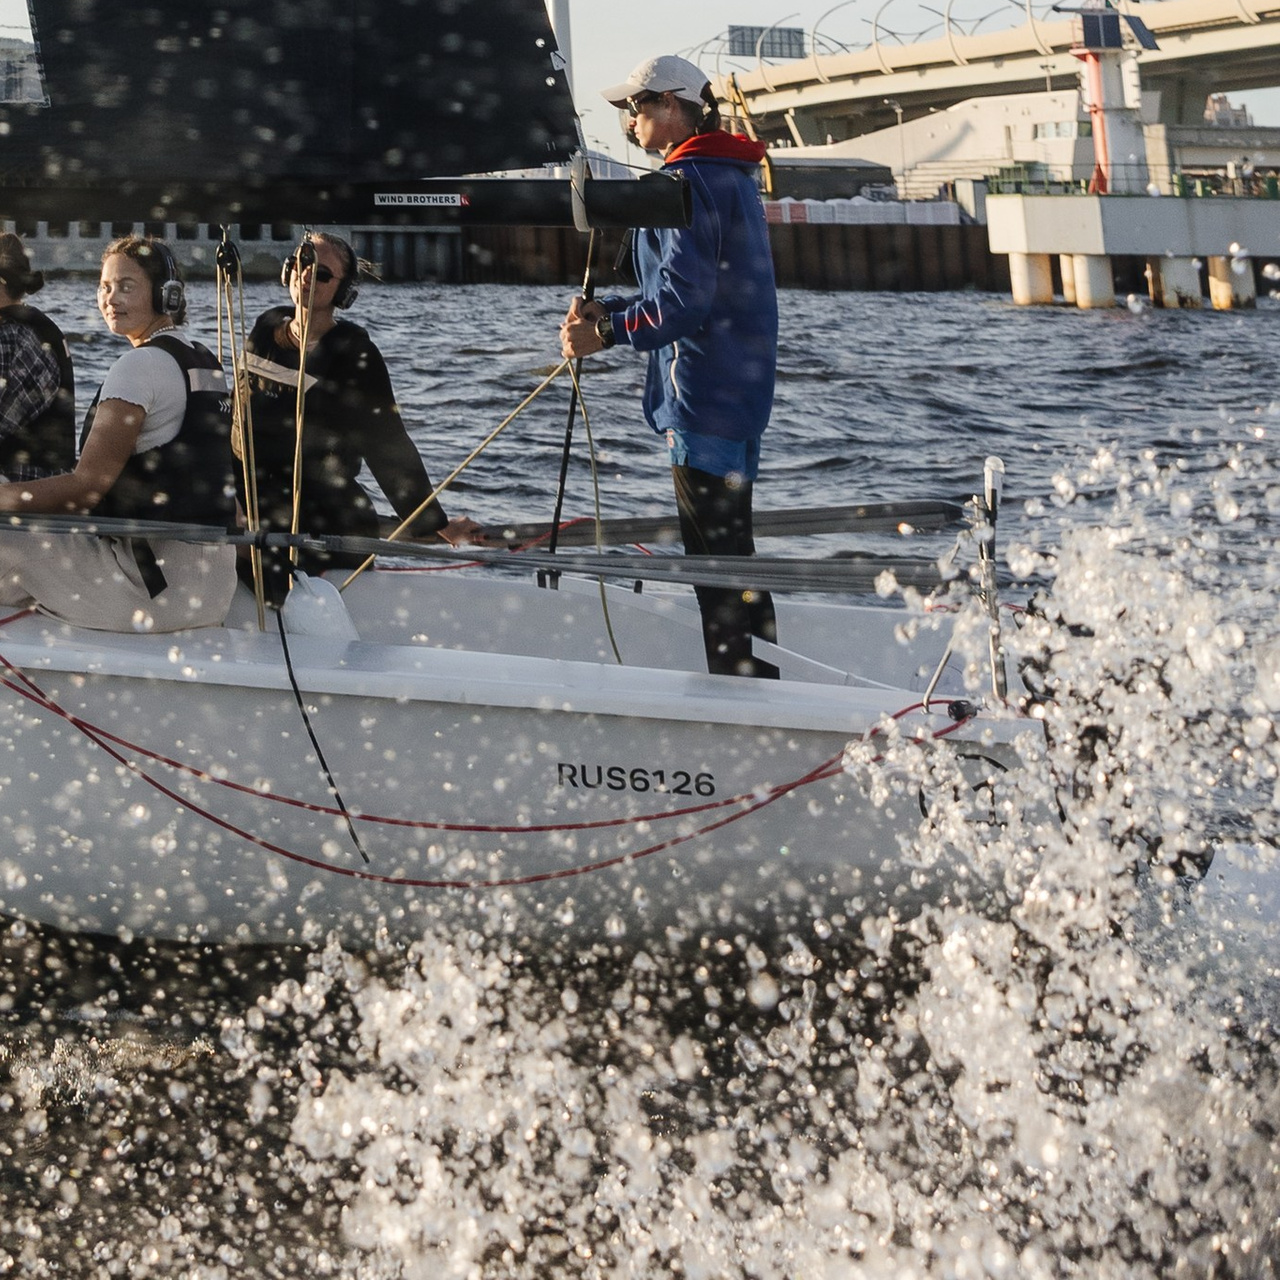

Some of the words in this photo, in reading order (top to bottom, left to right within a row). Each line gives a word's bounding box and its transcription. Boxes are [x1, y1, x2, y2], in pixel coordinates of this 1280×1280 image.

[378, 195, 404, 204] WIND
[407, 195, 456, 204] BROTHERS
[557, 762, 716, 797] RUS6126
